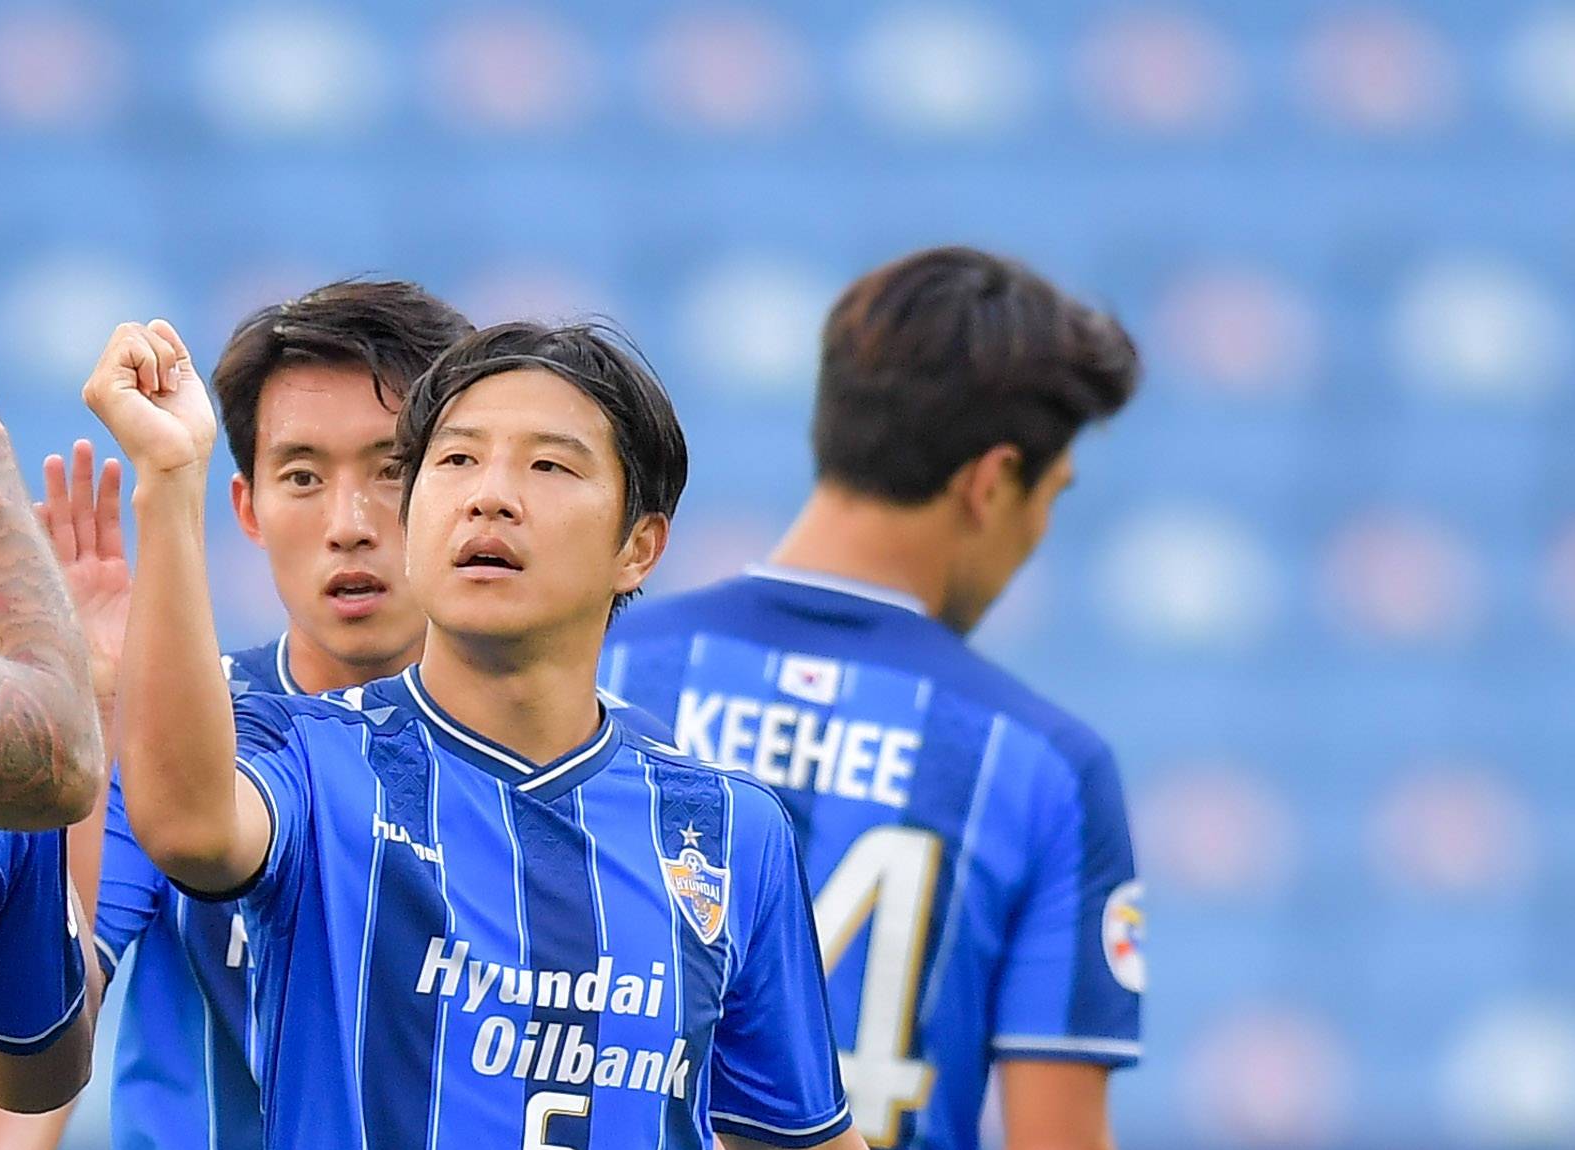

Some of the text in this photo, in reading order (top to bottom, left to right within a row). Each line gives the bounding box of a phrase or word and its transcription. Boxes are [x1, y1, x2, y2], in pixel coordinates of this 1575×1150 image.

[674, 688, 923, 809] KEEHEE
[415, 936, 666, 1018] Hyundai
[471, 1015, 691, 1100] Oilbank
